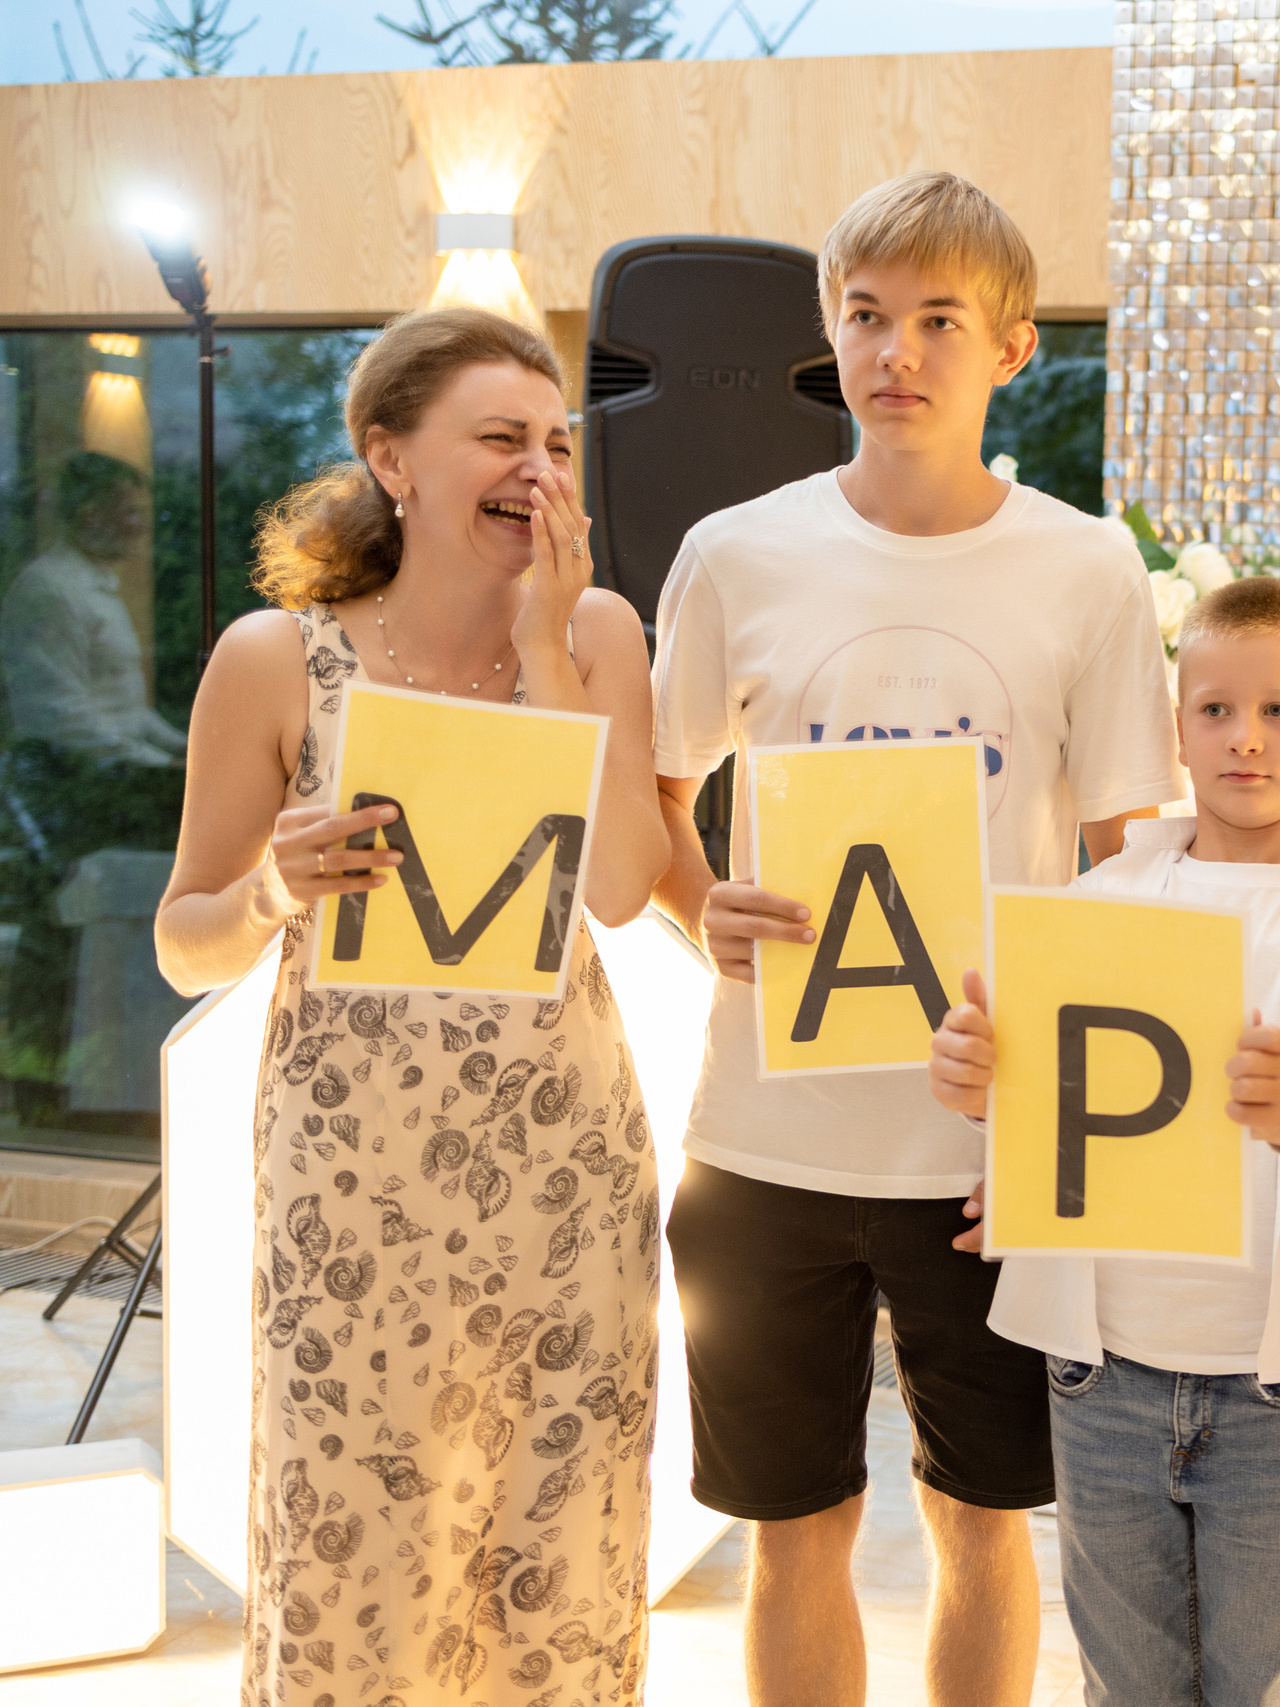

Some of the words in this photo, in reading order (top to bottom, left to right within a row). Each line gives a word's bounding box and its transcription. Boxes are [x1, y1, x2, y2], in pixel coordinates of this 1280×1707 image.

[877, 675, 902, 689] EST.
[332, 791, 587, 973] М
[790, 843, 952, 1043] А
[1056, 1003, 1192, 1219] Р
